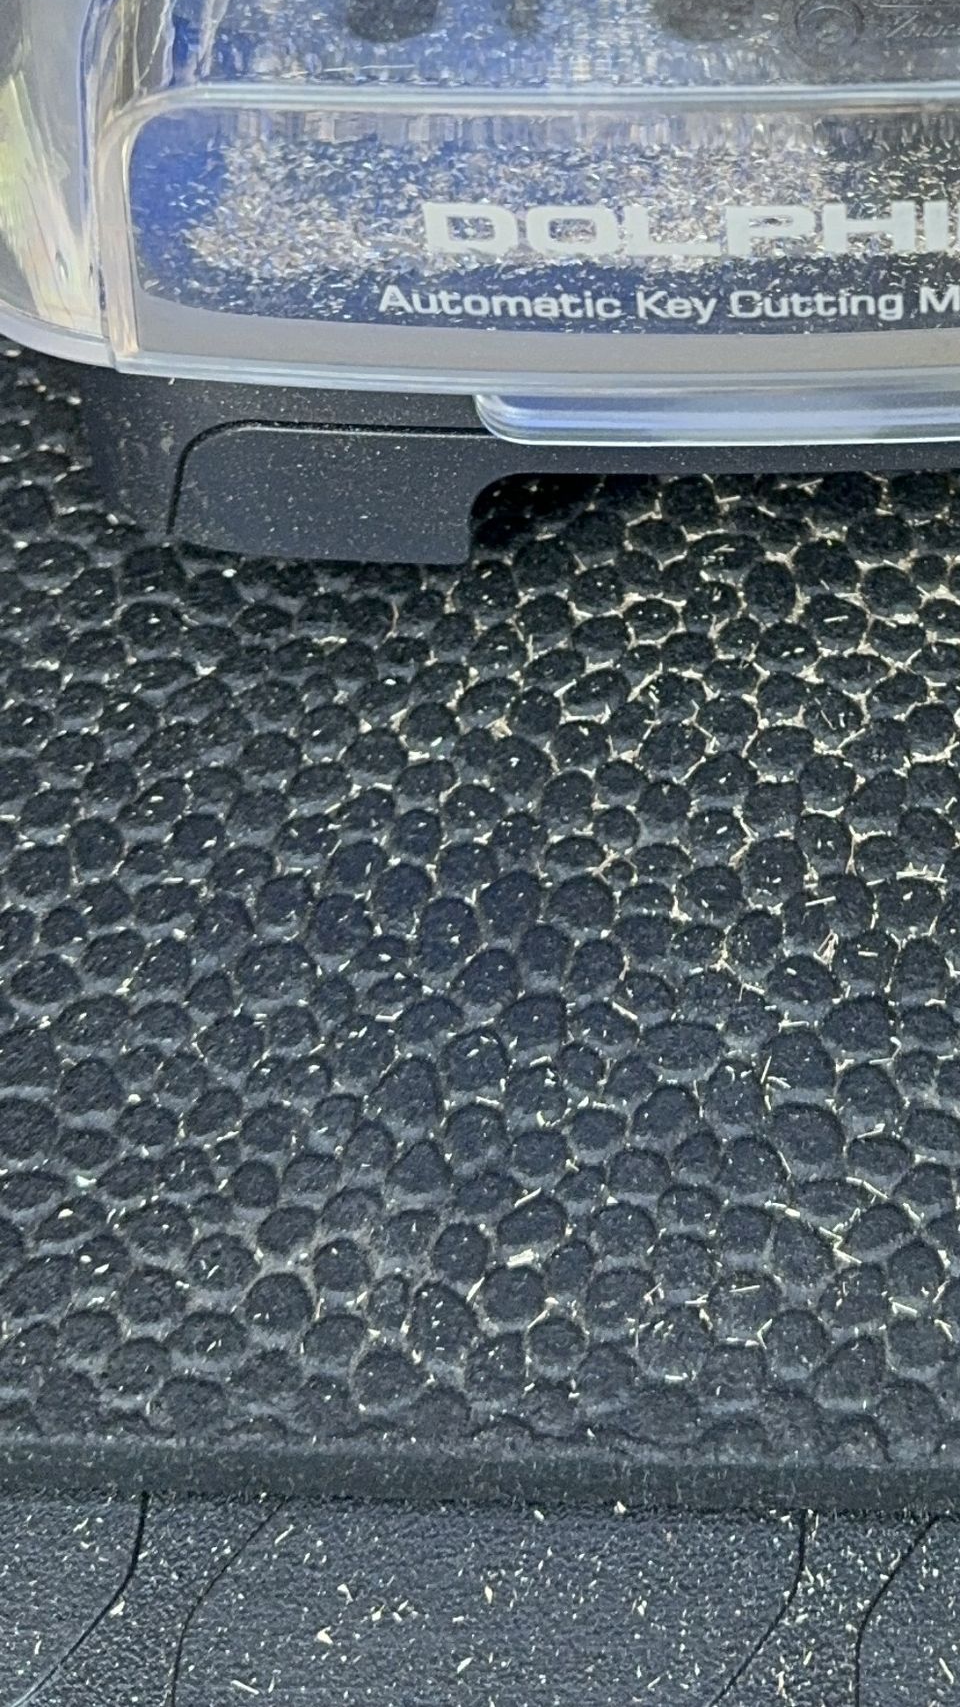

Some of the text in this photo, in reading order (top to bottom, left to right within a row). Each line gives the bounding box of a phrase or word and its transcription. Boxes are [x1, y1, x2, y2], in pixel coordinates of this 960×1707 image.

[378, 284, 622, 320] Automatic
[636, 290, 718, 324] Key
[729, 288, 903, 321] Cutting
